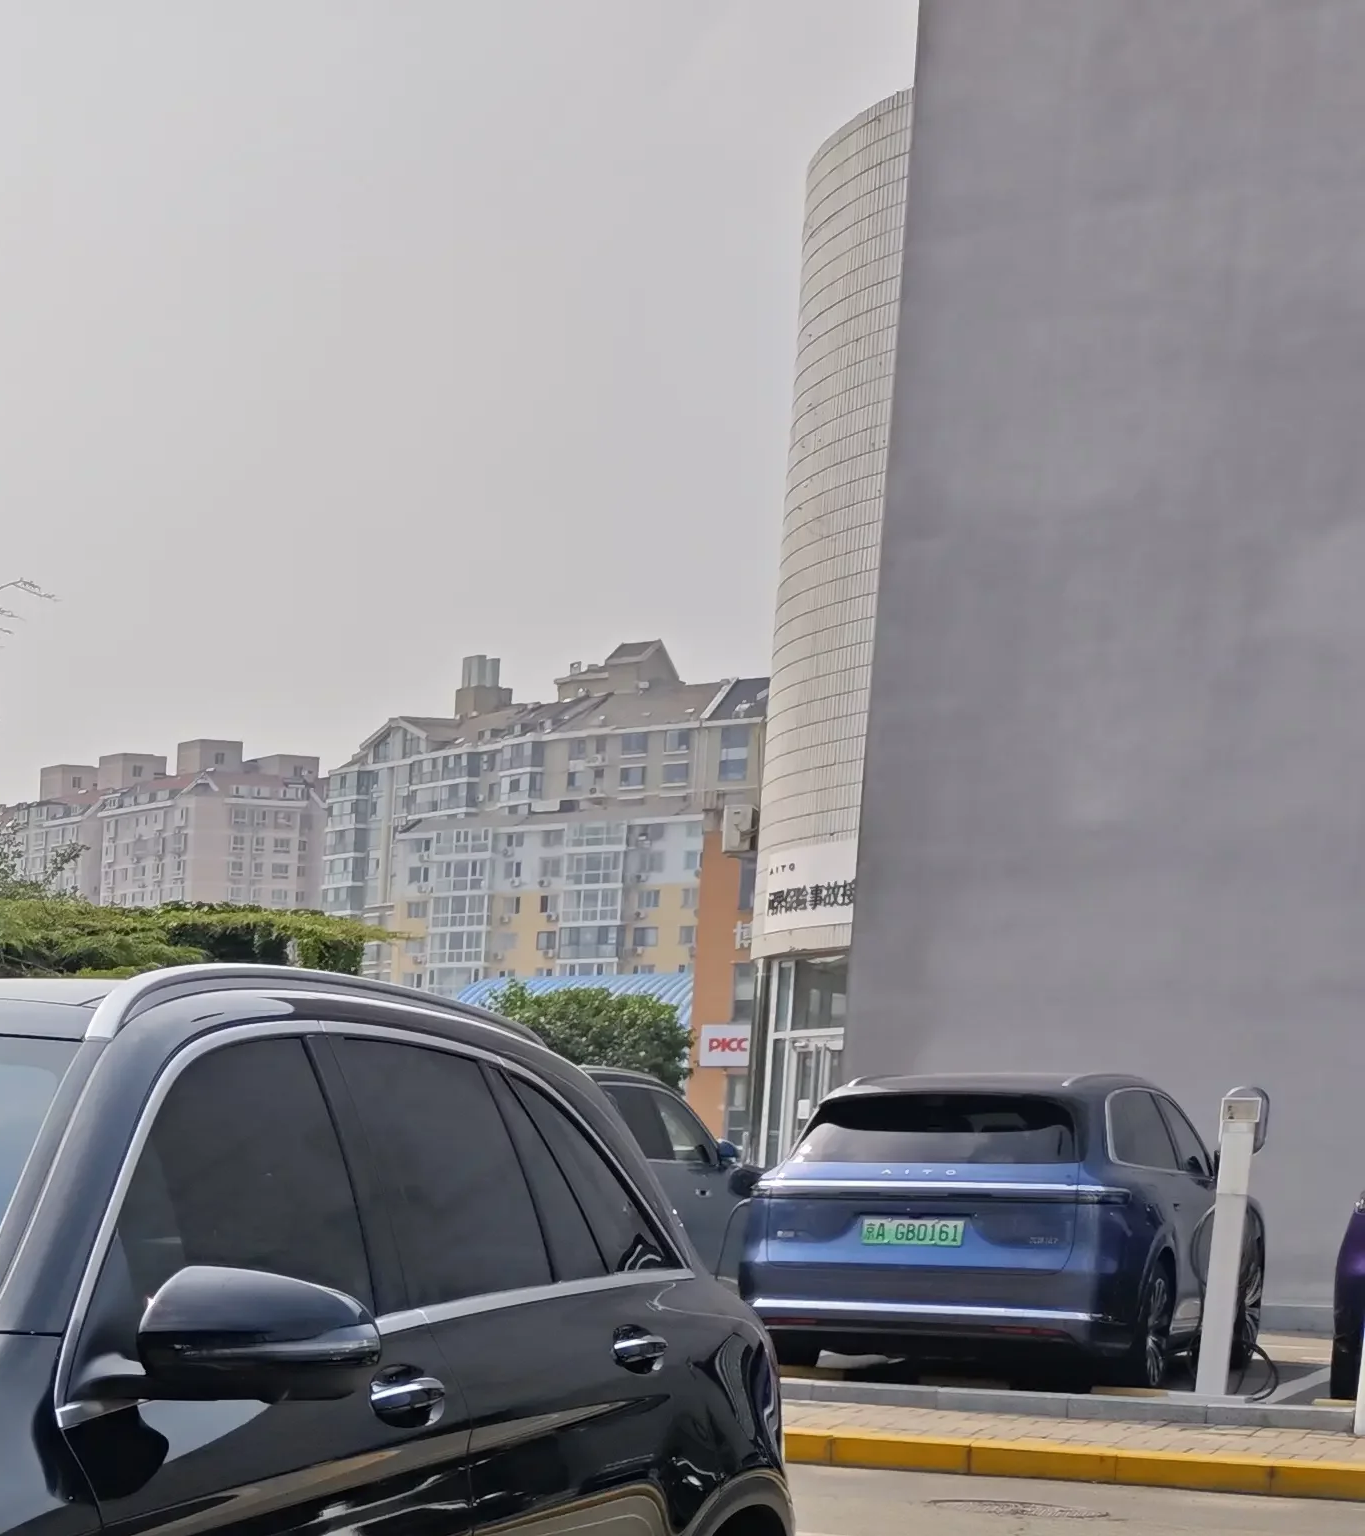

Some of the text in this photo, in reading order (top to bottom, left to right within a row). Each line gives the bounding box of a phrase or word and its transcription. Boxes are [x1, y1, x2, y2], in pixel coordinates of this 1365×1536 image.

[770, 863, 795, 875] AITO
[708, 1038, 748, 1052] PICC
[881, 1168, 957, 1177] AITO
